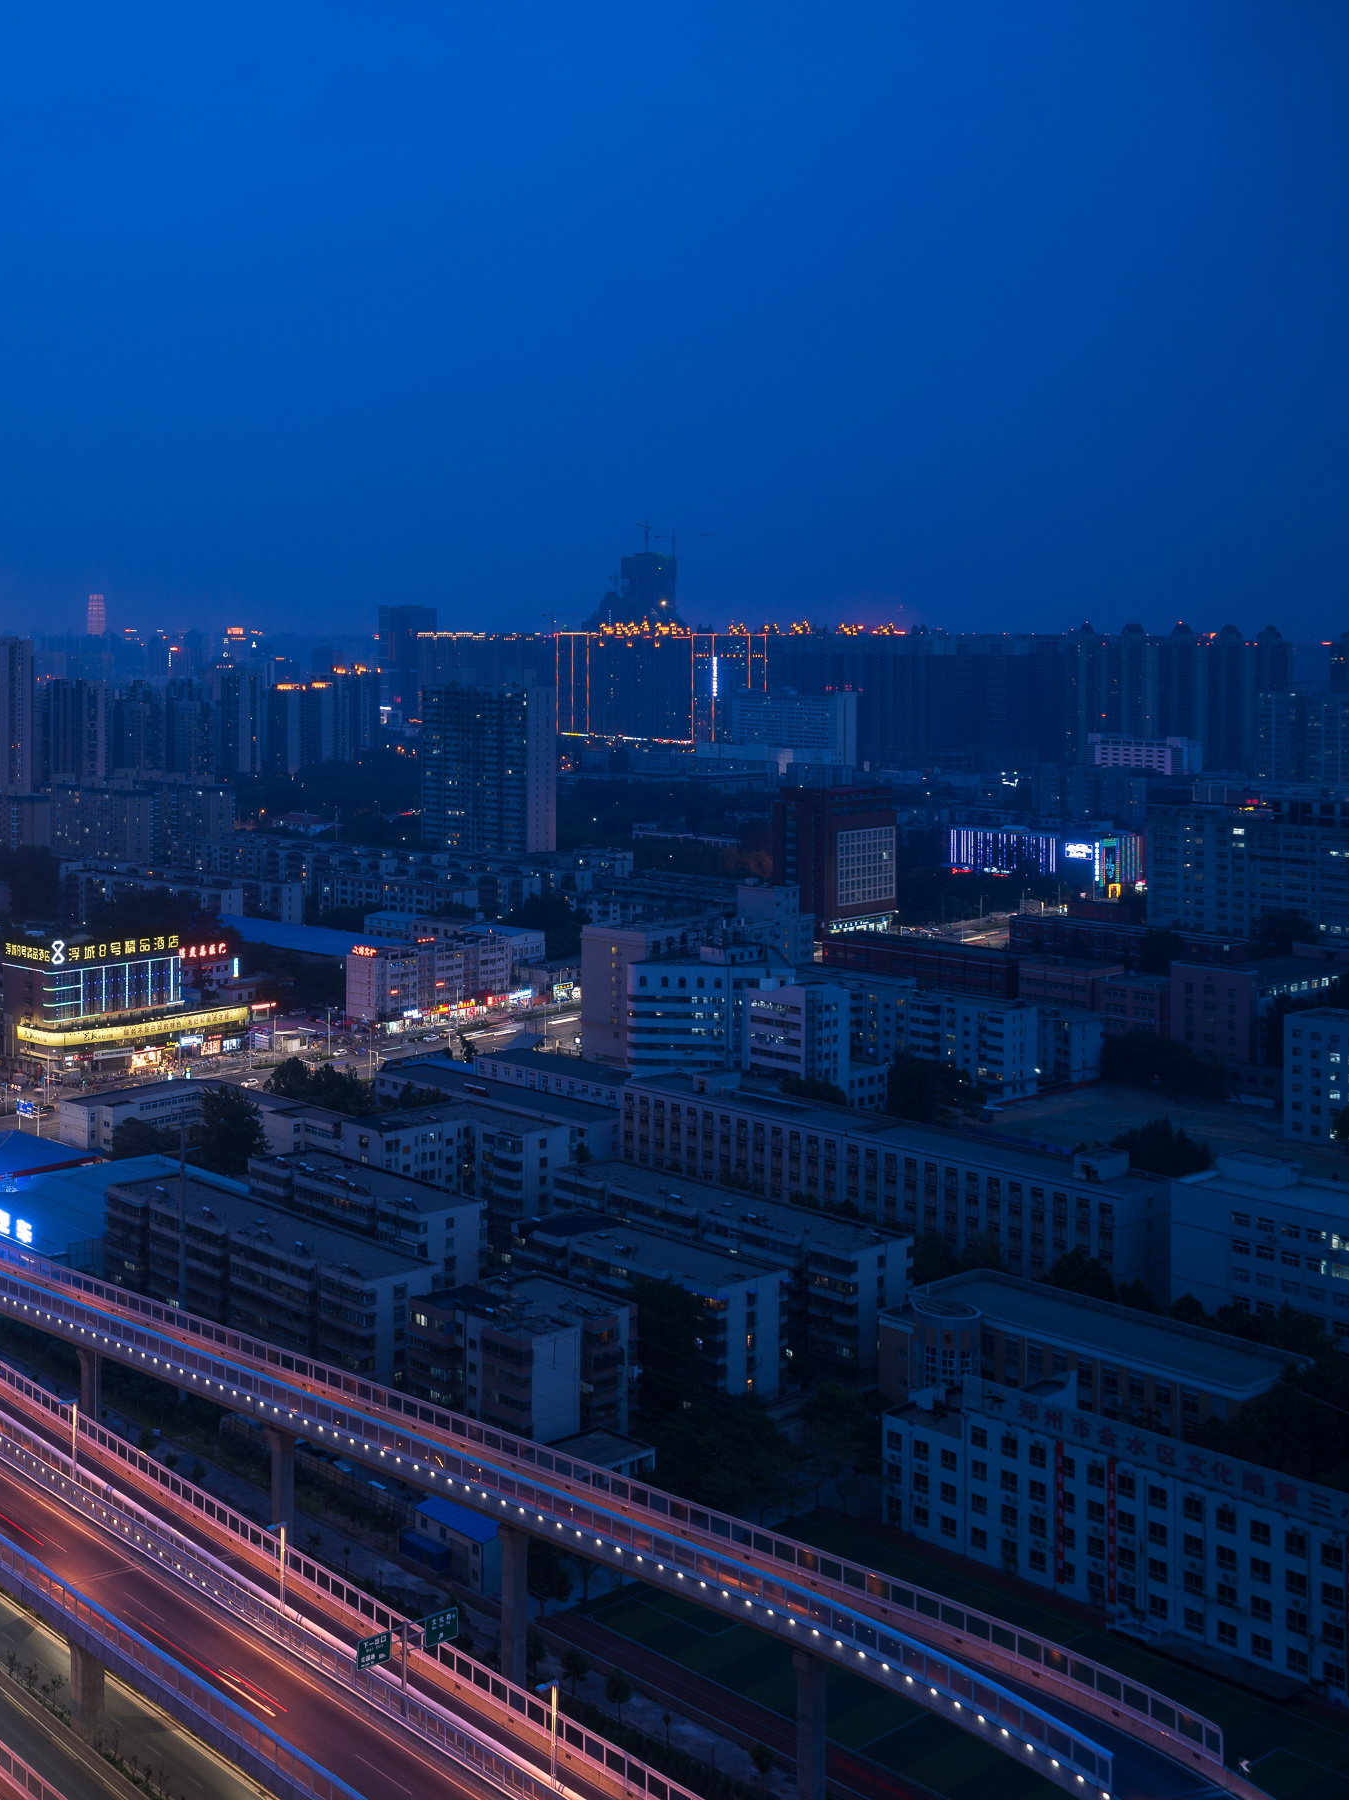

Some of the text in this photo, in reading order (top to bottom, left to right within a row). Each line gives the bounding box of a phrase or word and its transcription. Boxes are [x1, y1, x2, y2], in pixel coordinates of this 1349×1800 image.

[5, 941, 51, 963] 浮城8号精品酒店
[68, 934, 179, 962] 浮城8号精品酒店
[1018, 1398, 1349, 1518] 郑州市金水区文化路第三
[431, 1613, 452, 1626] 文化路
[363, 1635, 387, 1649] 下一出口
